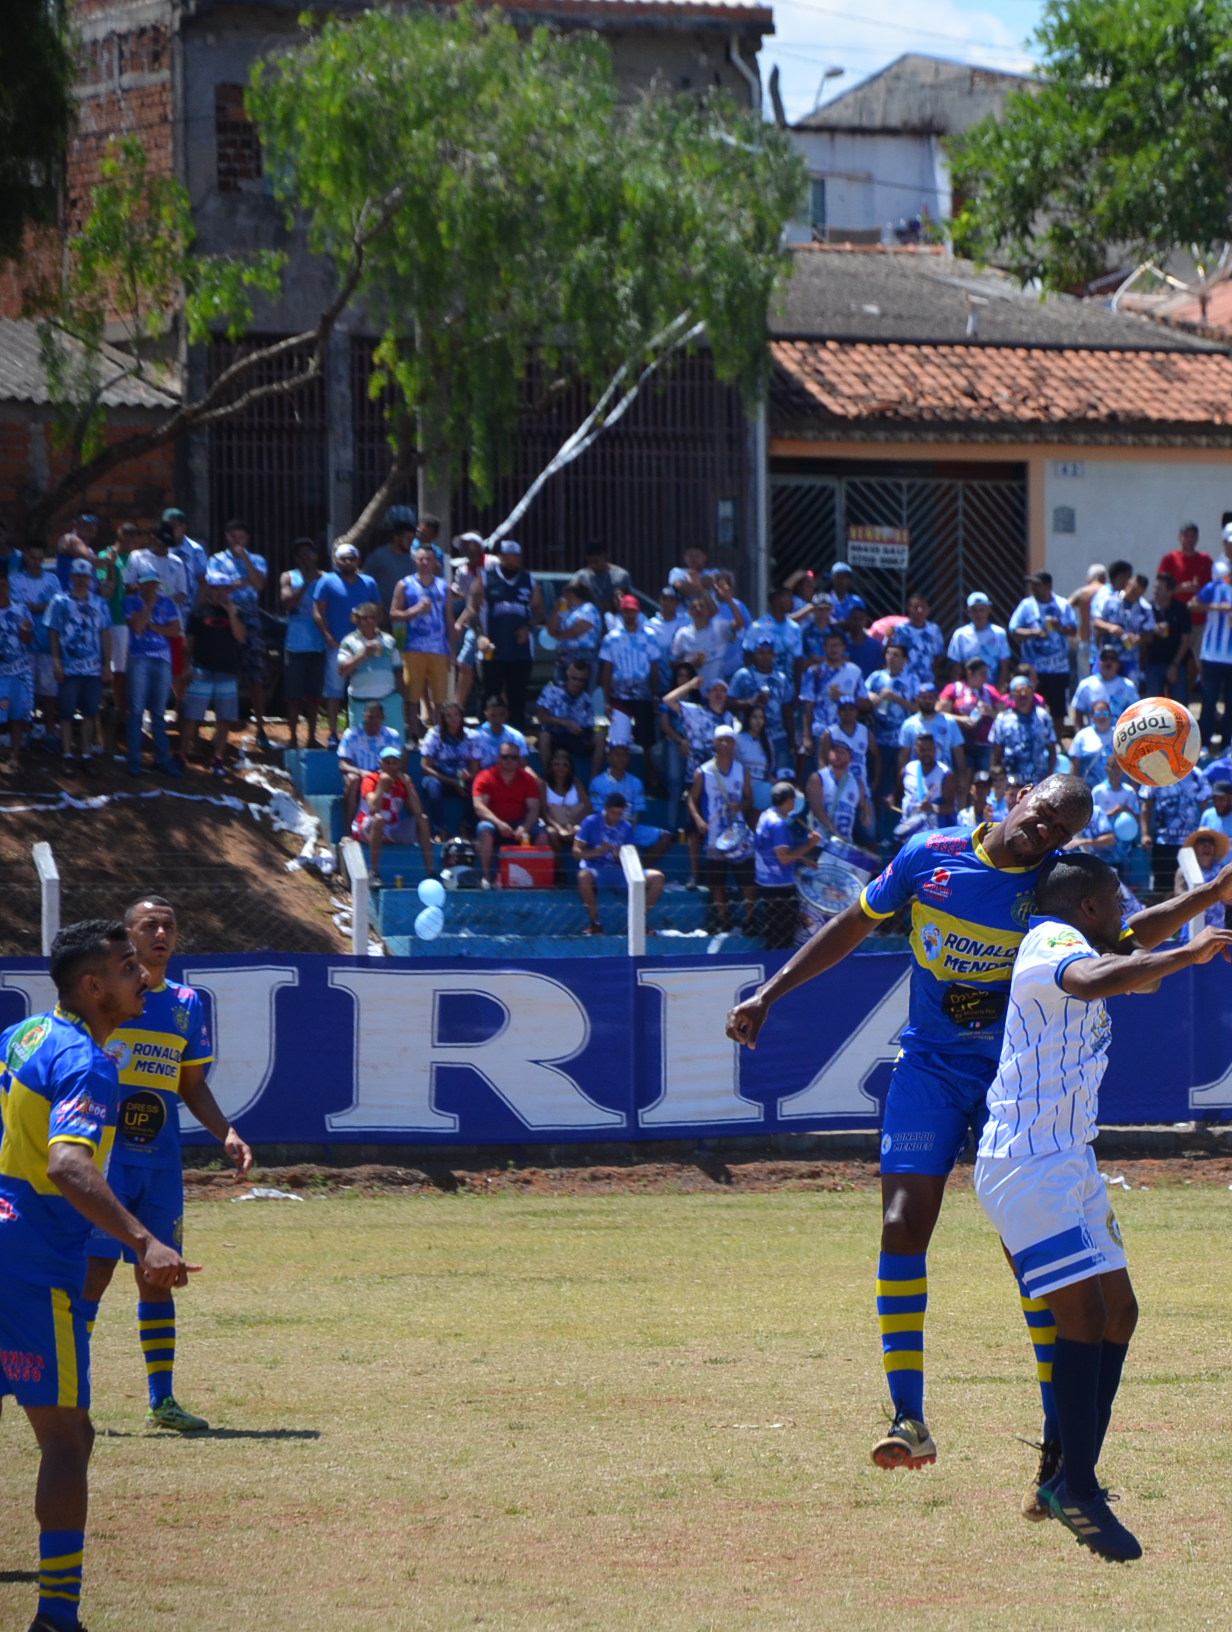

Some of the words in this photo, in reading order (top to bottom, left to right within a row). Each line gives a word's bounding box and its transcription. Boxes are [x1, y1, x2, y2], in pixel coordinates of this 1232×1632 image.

[1117, 716, 1171, 748] Topper
[944, 932, 1020, 958] RONALD
[943, 954, 1015, 974] MEND
[126, 1102, 159, 1114] DRESS
[124, 1111, 150, 1127] UP
[893, 1131, 935, 1142] RONALDO
[893, 1142, 934, 1153] MENDES
